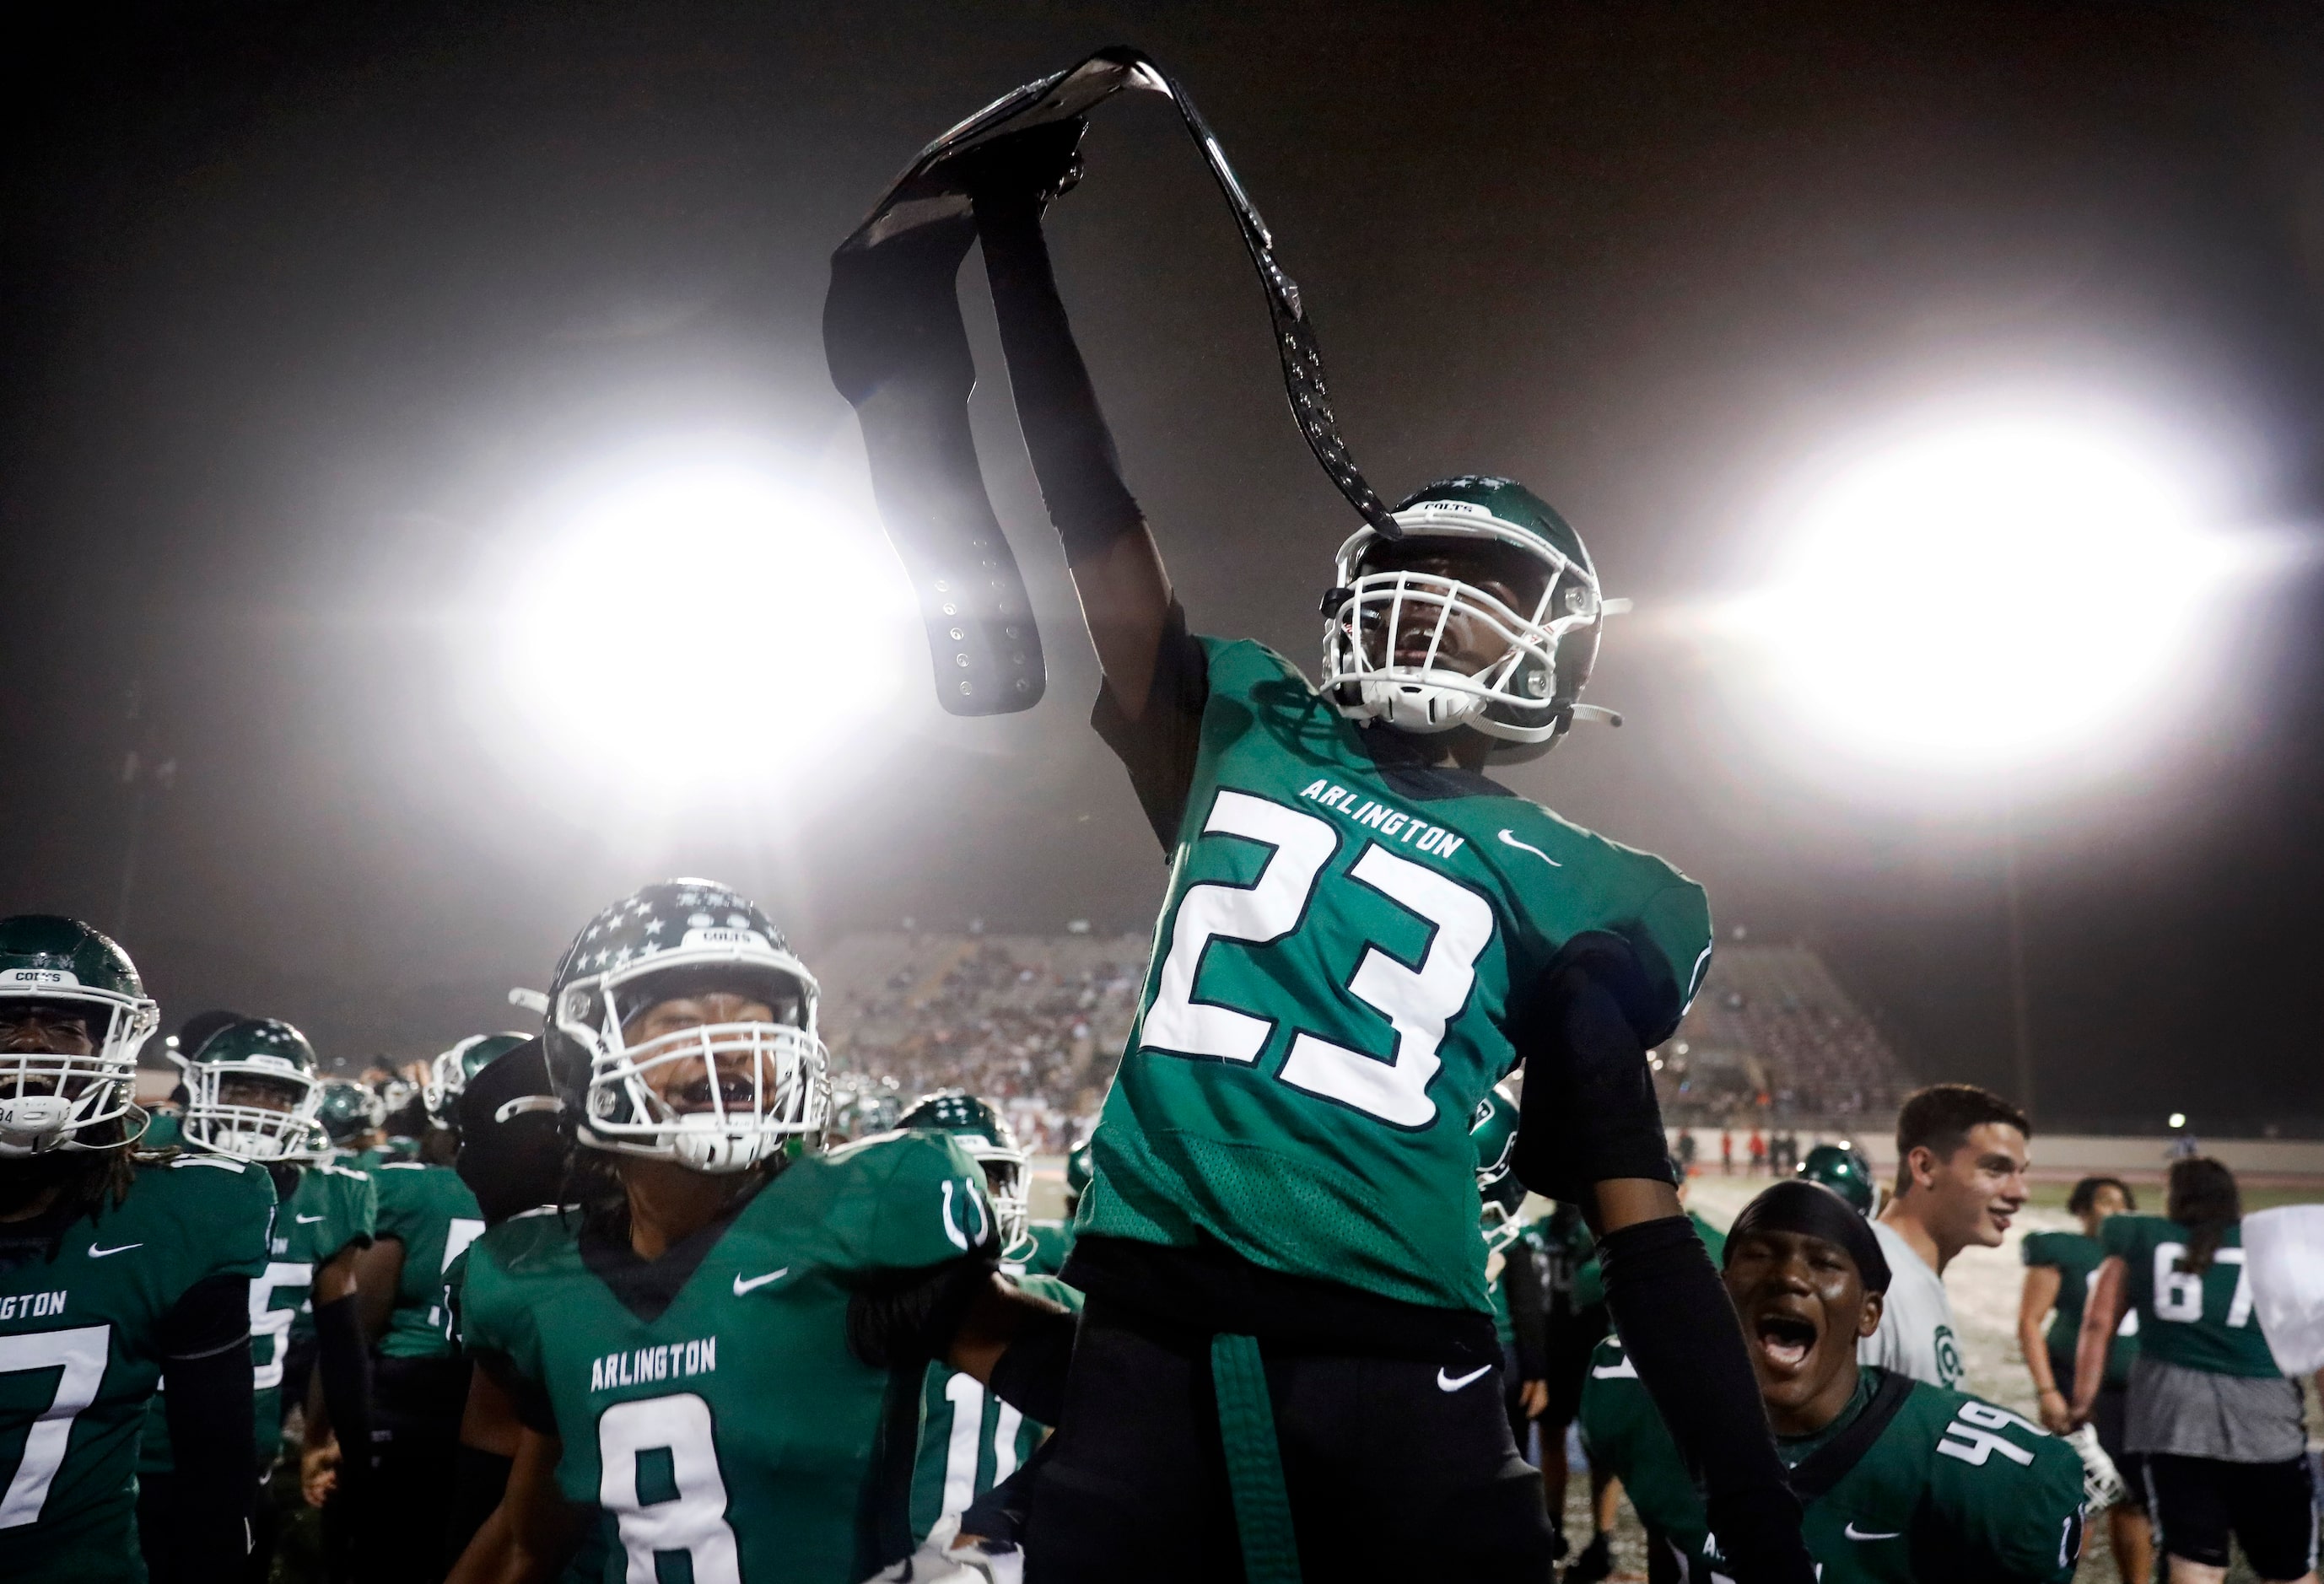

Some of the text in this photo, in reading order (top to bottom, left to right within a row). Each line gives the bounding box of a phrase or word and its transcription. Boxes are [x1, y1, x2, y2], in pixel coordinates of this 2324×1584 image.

[1423, 502, 1474, 513] COLTS
[1300, 779, 1465, 859] ARLINGTON
[1138, 787, 1496, 1130] 23
[0, 1290, 67, 1321] GTON
[2154, 1241, 2254, 1328] 67
[590, 1335, 717, 1393] ARLINGTON
[1935, 1400, 2052, 1468] 49
[598, 1392, 742, 1584] 8
